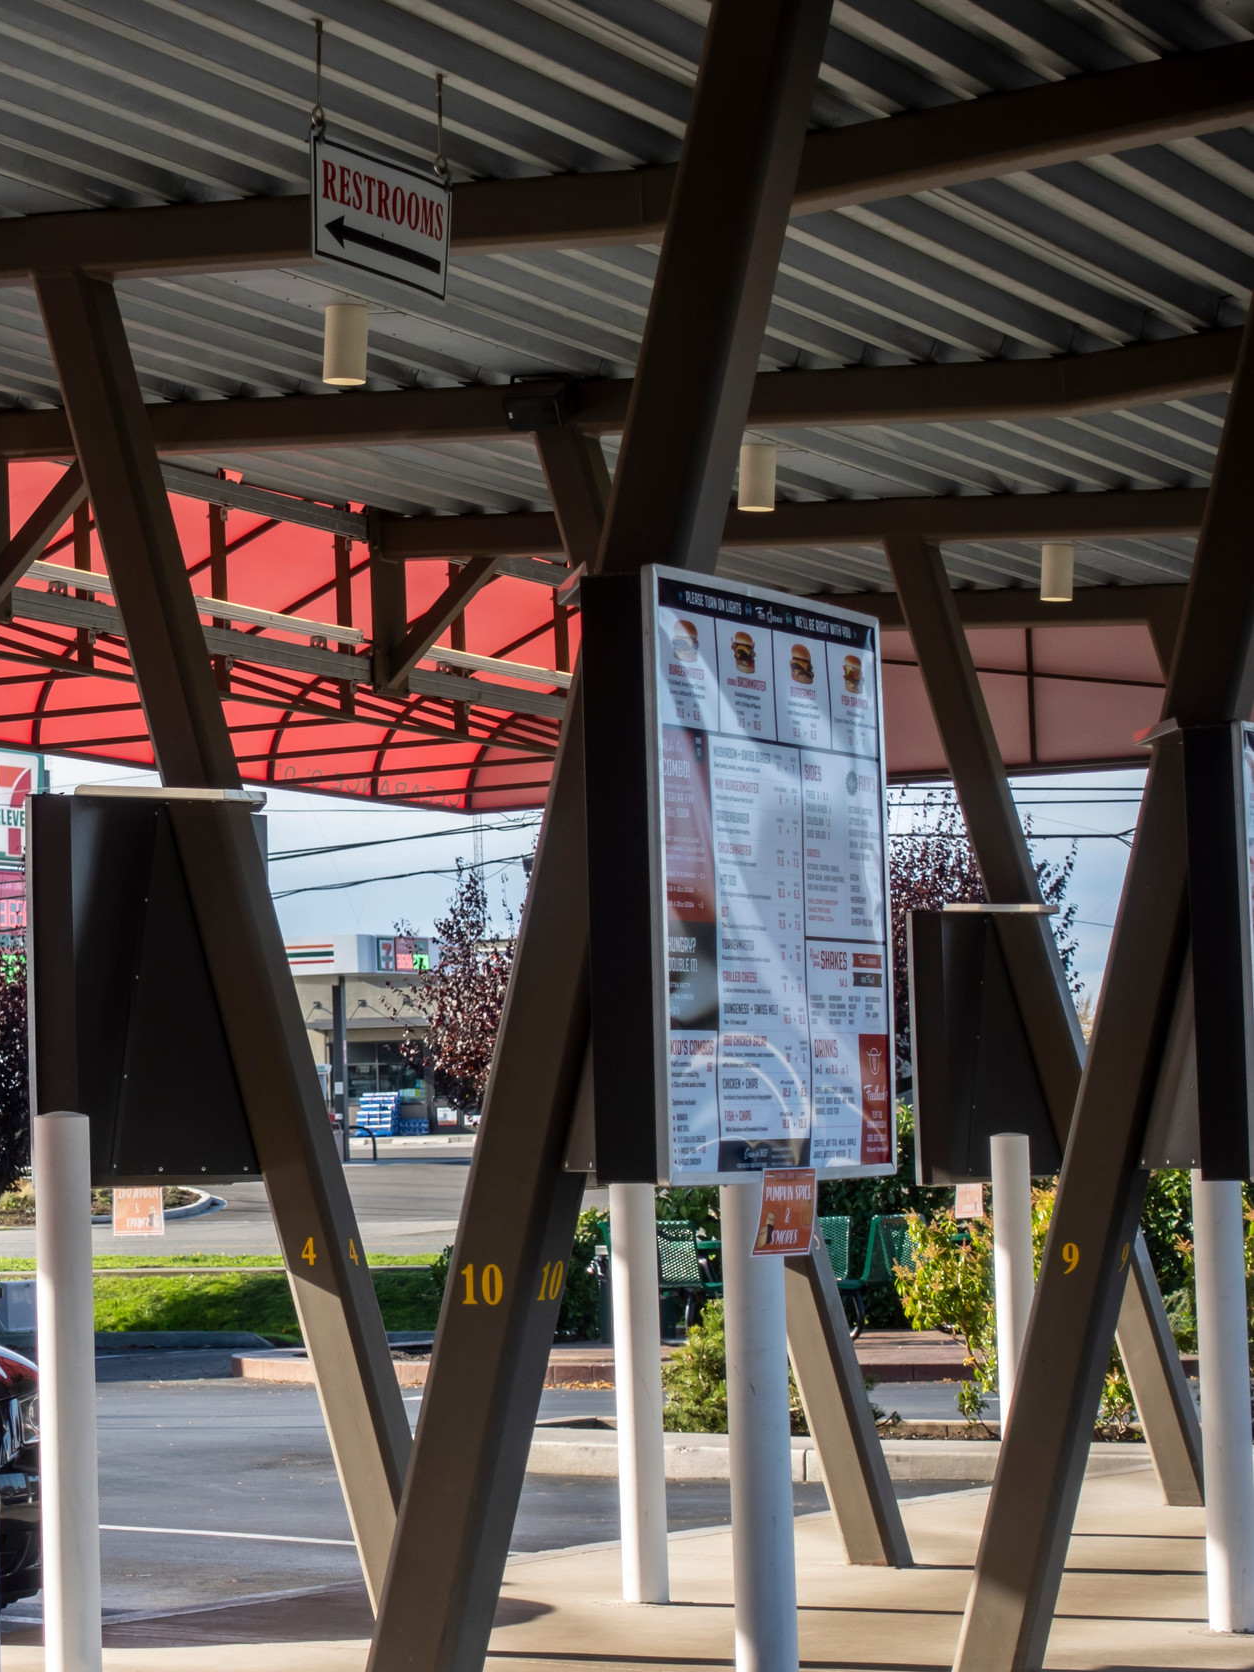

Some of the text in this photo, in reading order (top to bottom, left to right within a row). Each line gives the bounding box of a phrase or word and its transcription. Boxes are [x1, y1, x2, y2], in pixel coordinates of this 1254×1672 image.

[322, 160, 443, 241] RESTROOMS
[685, 590, 703, 607] PLEASE
[704, 595, 716, 610] TURN
[717, 598, 724, 612] ON
[725, 599, 742, 615] LIGHTS
[808, 618, 814, 631] BE
[830, 622, 841, 636] WITH
[842, 625, 851, 639] YOU
[804, 763, 821, 782] SIDES
[668, 936, 696, 953] HUNGRY?
[820, 950, 847, 970] SHAKES
[669, 1040, 713, 1056] KID'S COMBOS
[813, 1039, 838, 1058] DRINKS
[766, 1184, 812, 1202] PUMPKIN SPICE
[301, 1237, 317, 1266] 4
[349, 1238, 359, 1266] 4
[1062, 1243, 1079, 1274] 9
[1118, 1242, 1130, 1273] 9
[461, 1263, 503, 1305] 10
[537, 1260, 564, 1301] 10
